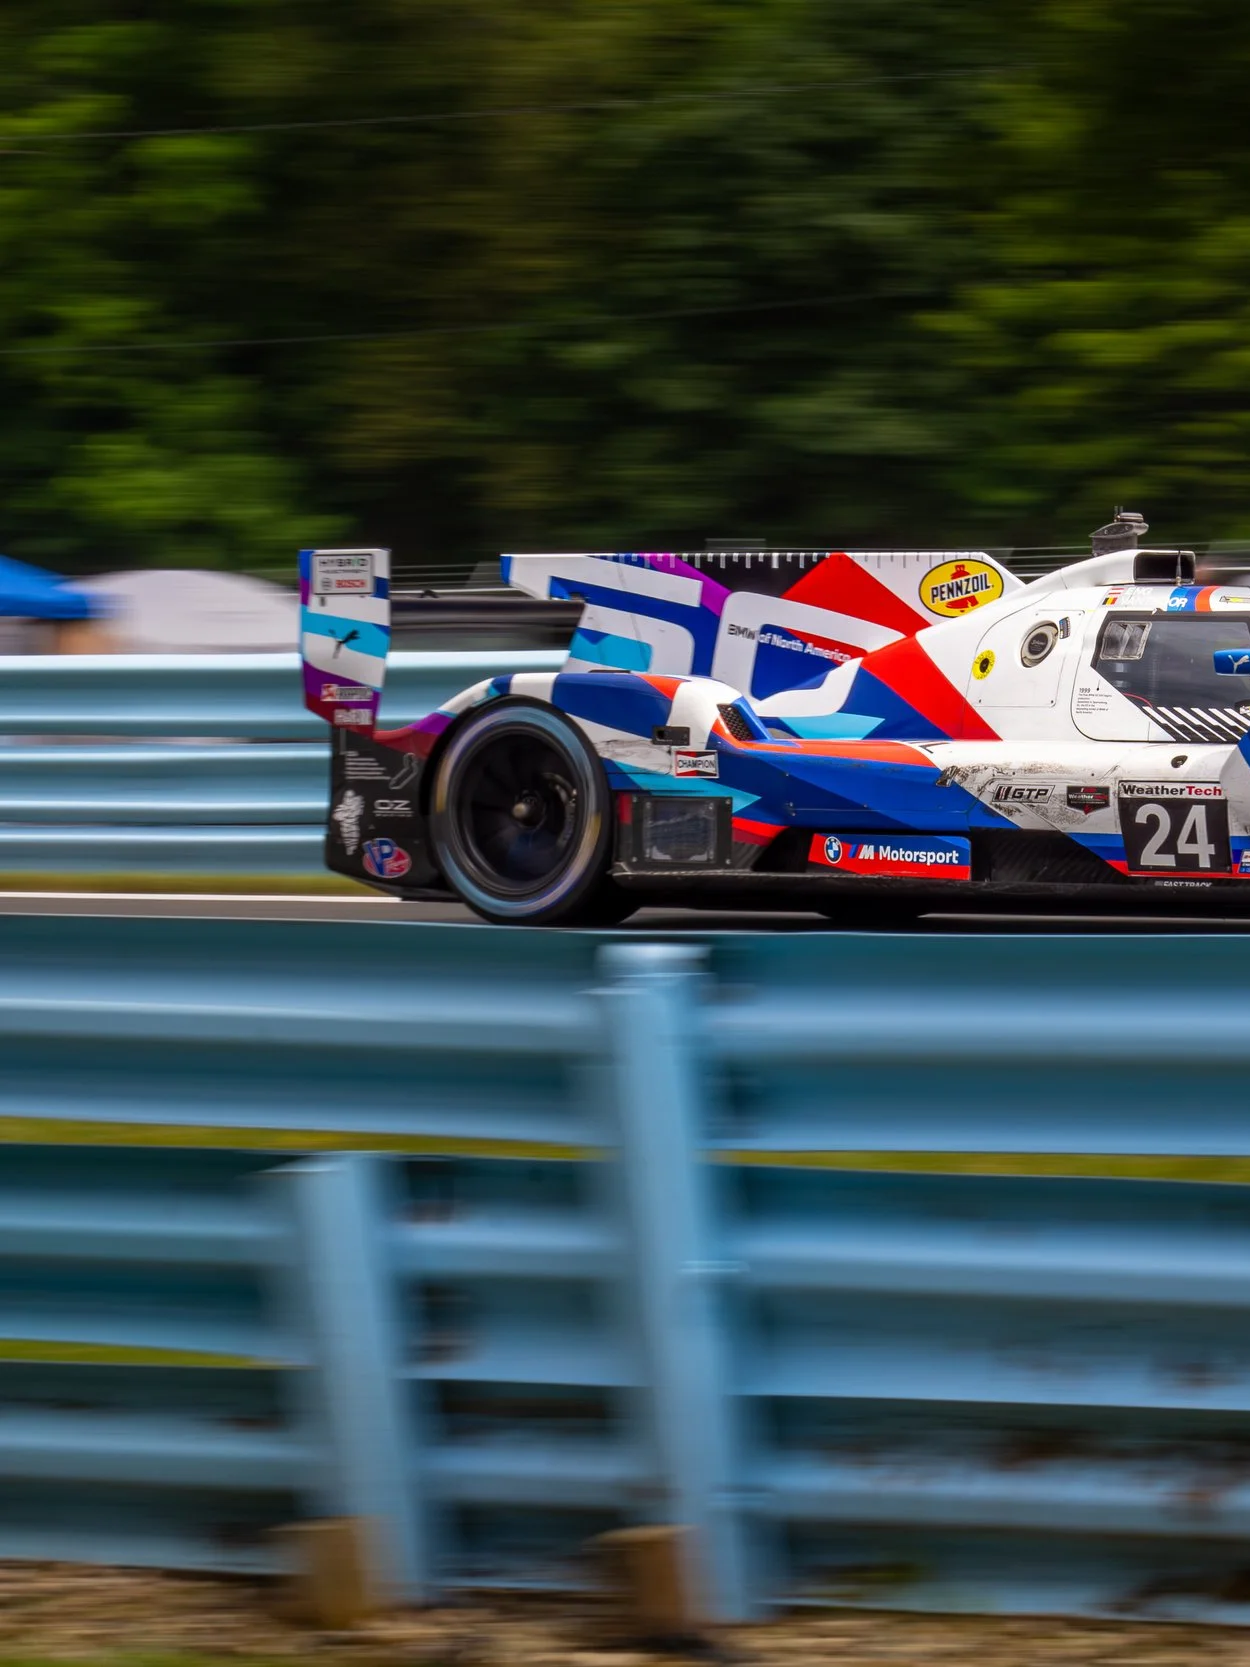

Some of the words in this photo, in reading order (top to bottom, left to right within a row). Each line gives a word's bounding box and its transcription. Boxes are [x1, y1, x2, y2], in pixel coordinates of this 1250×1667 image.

[930, 573, 991, 604] PENNZOIL
[759, 633, 772, 644] of
[771, 634, 804, 652] North
[804, 642, 853, 661] America
[678, 759, 715, 768] CHAMPION
[1011, 788, 1049, 800] GTP
[1121, 784, 1222, 797] WeatherTech
[373, 799, 411, 811] OZ
[1134, 803, 1216, 868] 24
[878, 845, 960, 866] Motorsport
